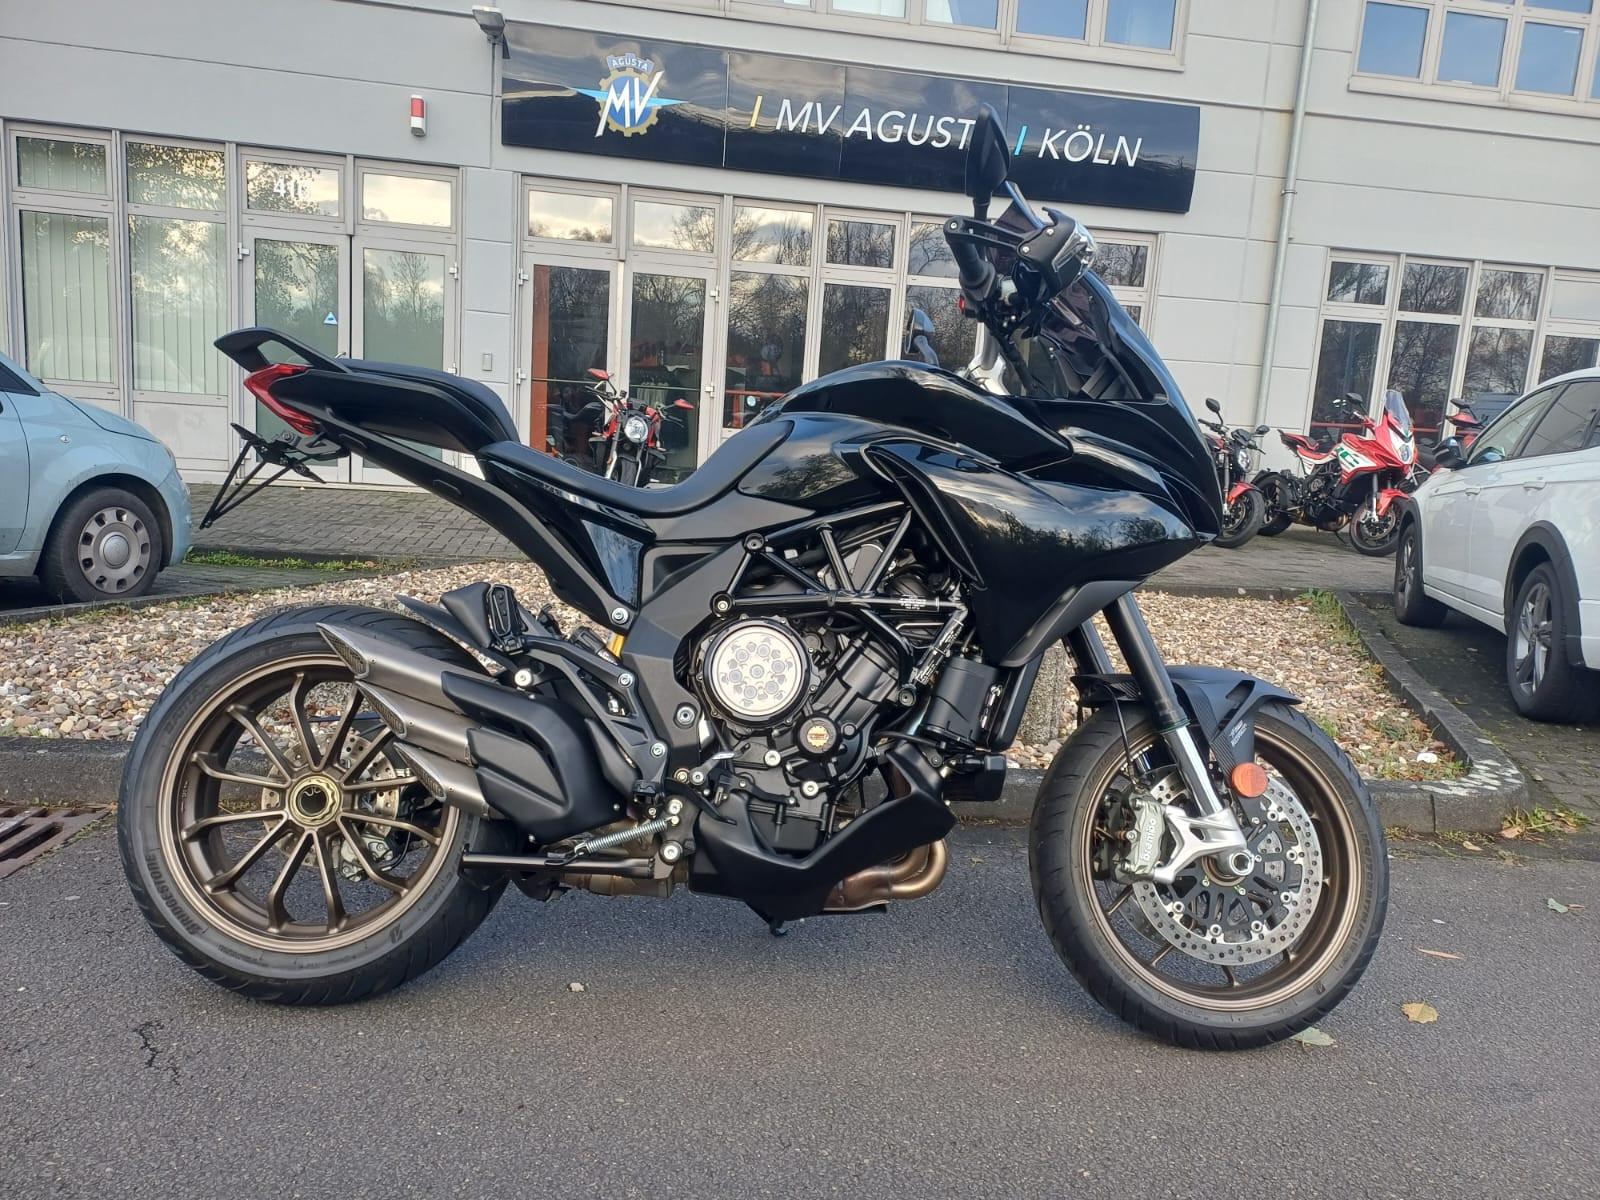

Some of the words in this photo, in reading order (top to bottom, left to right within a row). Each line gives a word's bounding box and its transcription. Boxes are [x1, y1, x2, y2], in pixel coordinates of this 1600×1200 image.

[612, 57, 649, 71] AGUSTA
[594, 70, 665, 138] MV
[776, 98, 842, 136] MV
[844, 107, 977, 150] AGUST
[1038, 124, 1142, 167] KÖLN
[1141, 818, 1156, 861] brembo
[146, 852, 202, 936] BRIDGESTONE
